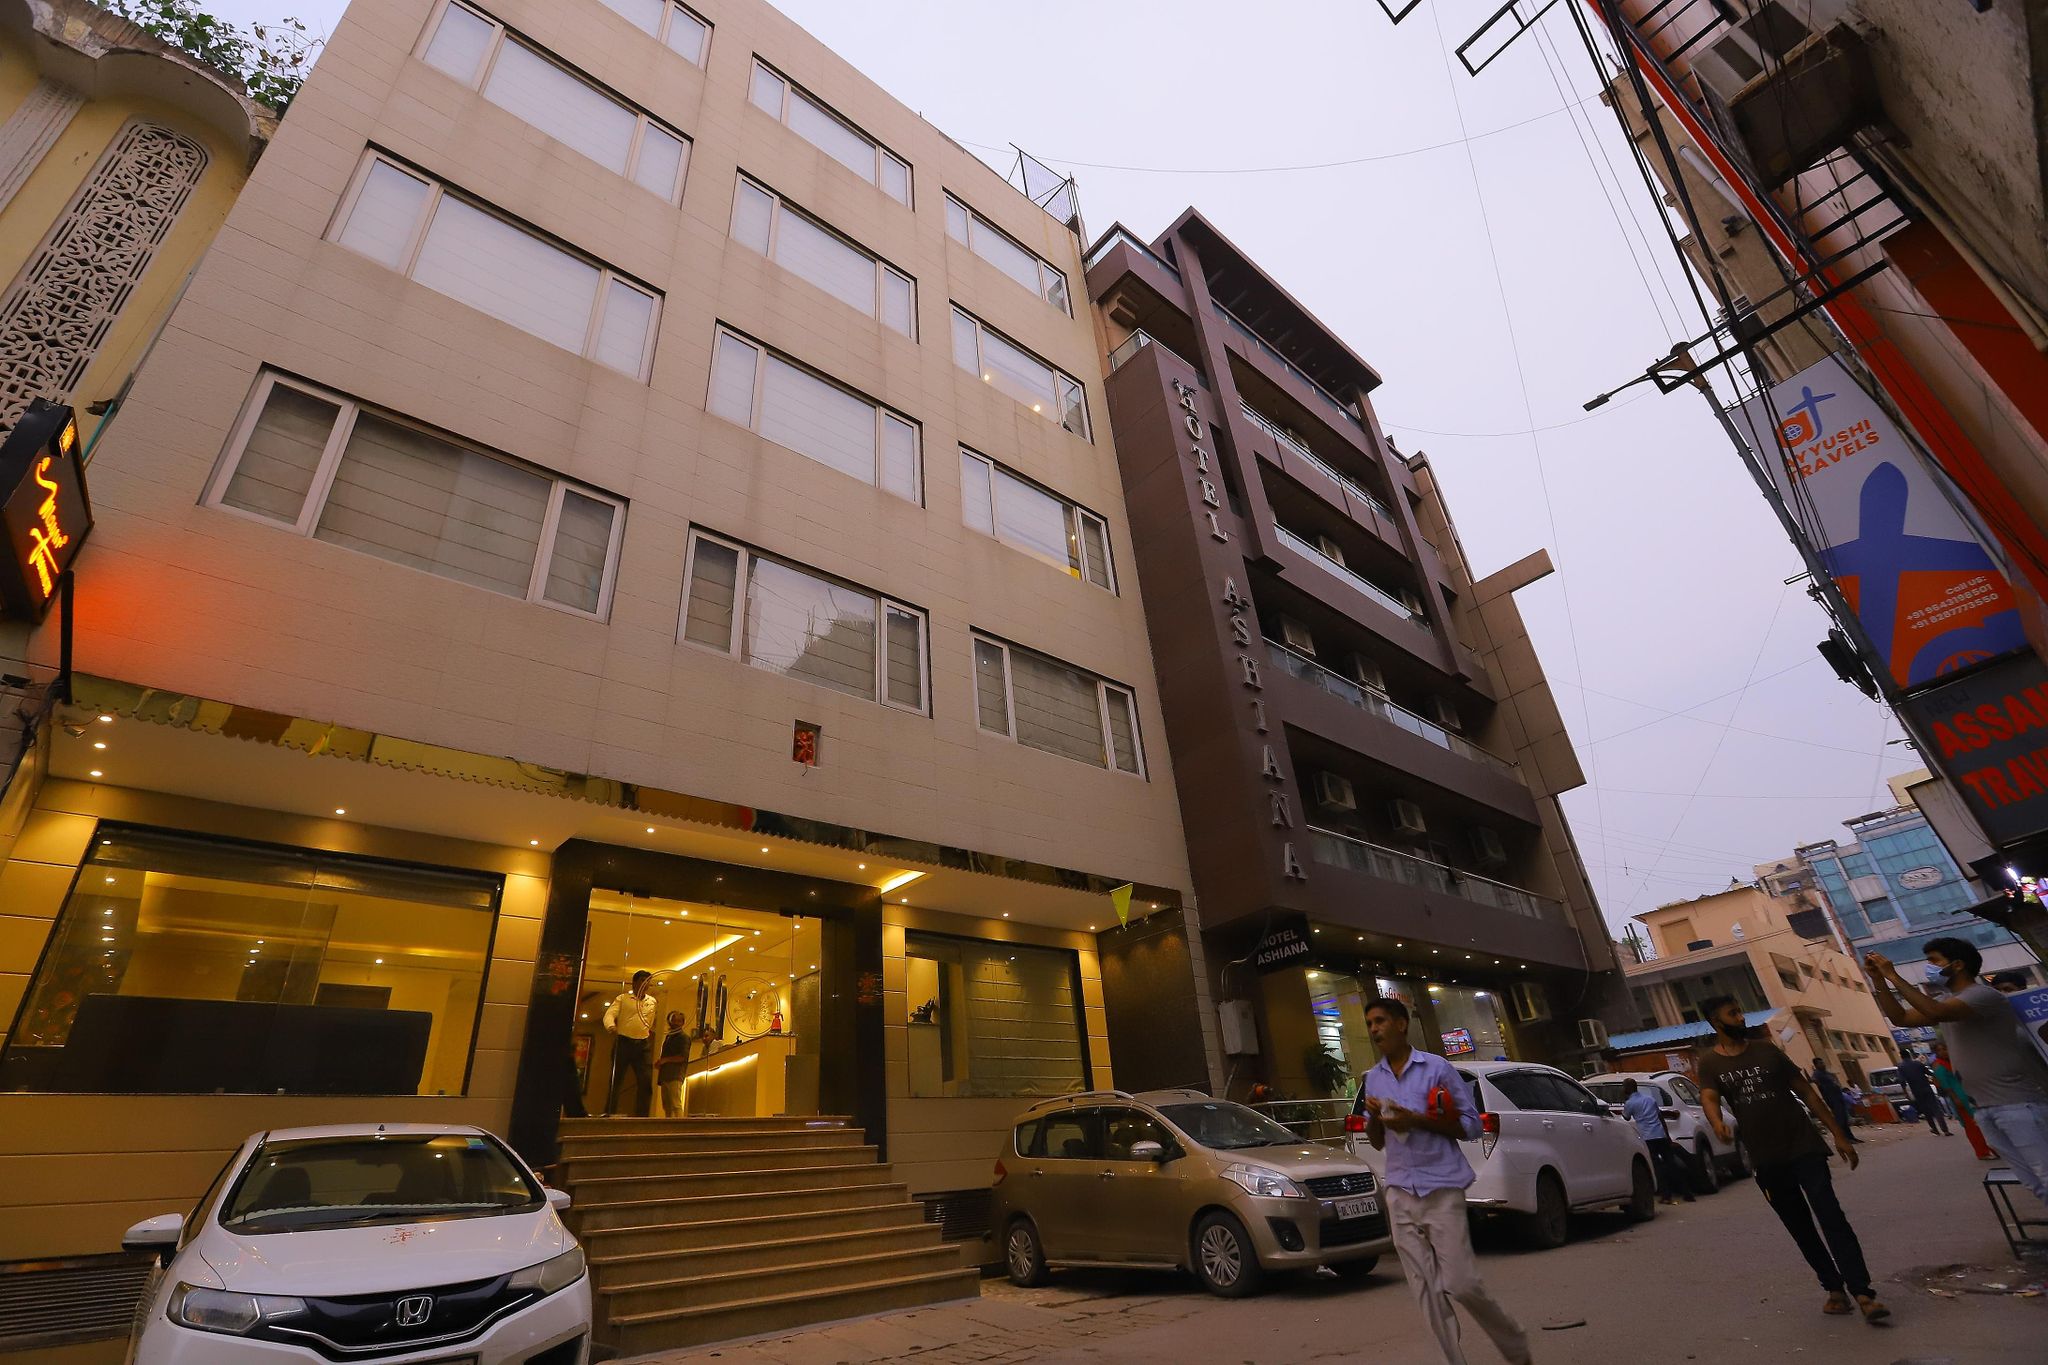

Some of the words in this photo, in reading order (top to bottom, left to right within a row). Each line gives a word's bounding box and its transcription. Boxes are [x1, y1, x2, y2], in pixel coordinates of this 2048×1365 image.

[1784, 431, 1880, 485] TRAVELS
[1945, 582, 1968, 595] Call
[1907, 609, 1925, 620] +91
[1911, 619, 1930, 630] +91
[1173, 378, 1229, 544] HOTEL
[1223, 576, 1308, 880] ASHIANA
[1961, 748, 2048, 811] TRAV
[1261, 929, 1299, 949] HOTEL
[1257, 941, 1309, 966] ASHIANA
